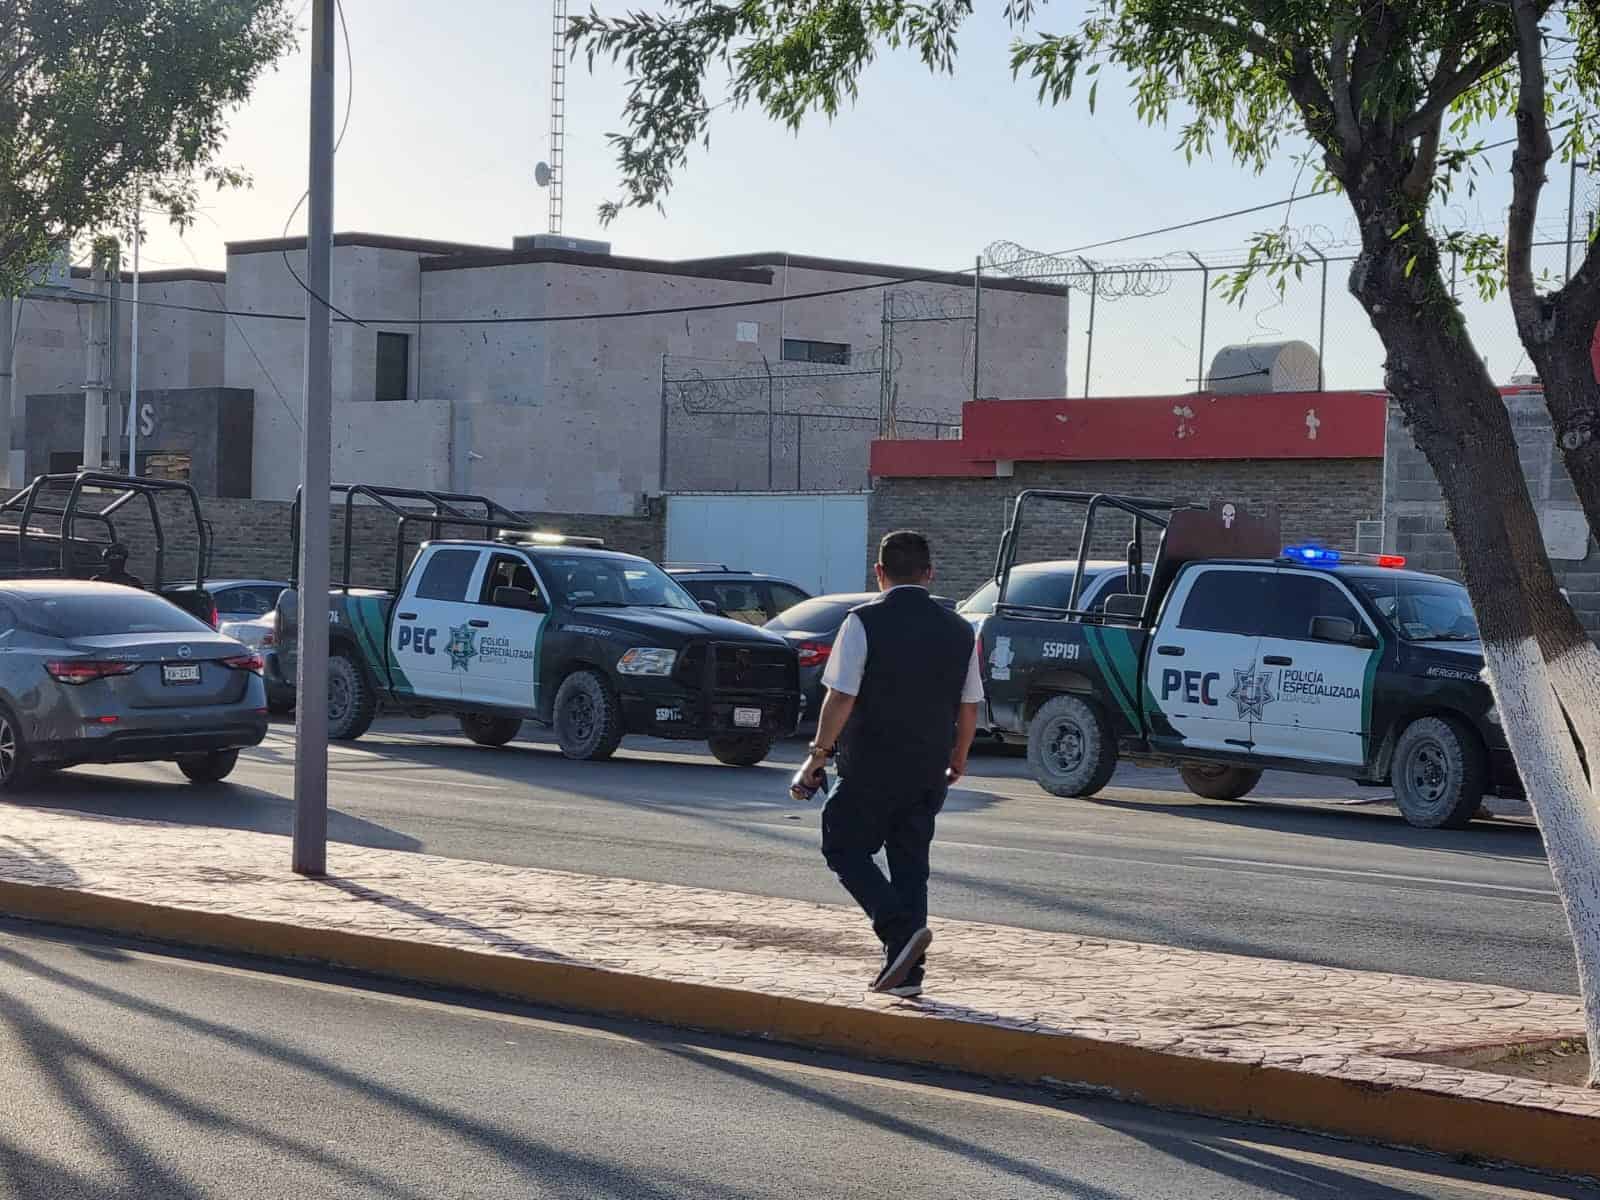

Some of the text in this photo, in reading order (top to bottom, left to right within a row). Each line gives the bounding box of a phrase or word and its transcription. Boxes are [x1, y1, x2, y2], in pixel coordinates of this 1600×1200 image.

[398, 626, 437, 655] PEC
[480, 645, 534, 660] ESPECIALIZADA
[1042, 641, 1080, 659] SSP191
[1283, 669, 1324, 683] POLICÍA
[1161, 668, 1220, 706] PEC
[1283, 681, 1361, 700] ESPECIALIZADA
